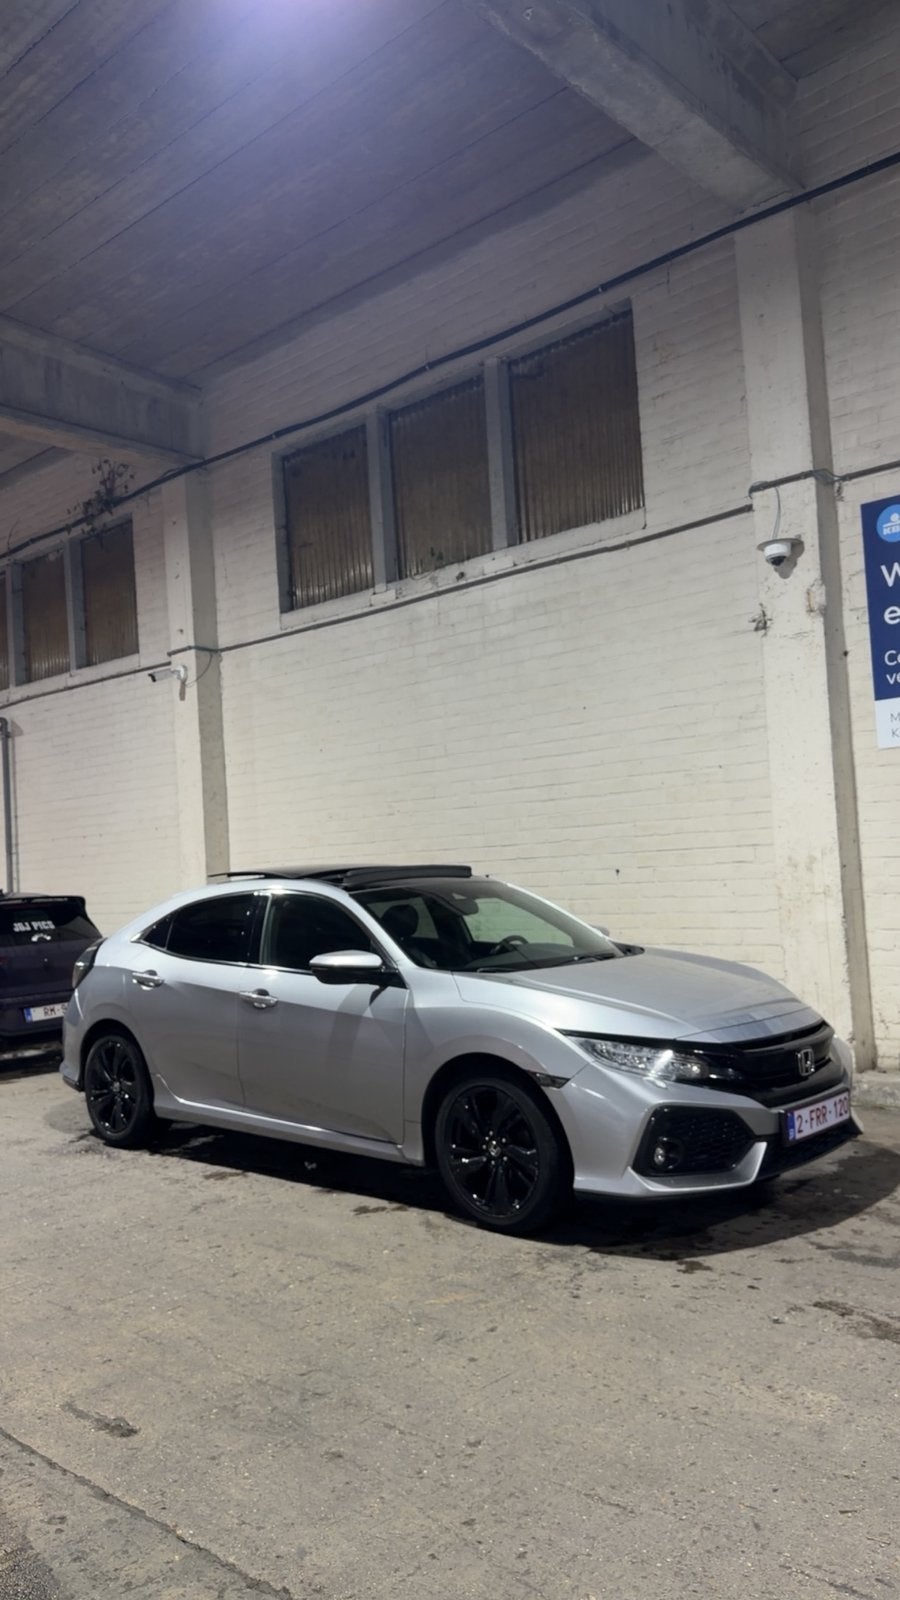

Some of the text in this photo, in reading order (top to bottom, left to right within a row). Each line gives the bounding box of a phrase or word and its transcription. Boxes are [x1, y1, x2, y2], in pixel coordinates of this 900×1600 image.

[883, 524, 900, 535] KB
[881, 562, 900, 588] W
[883, 605, 900, 625] e
